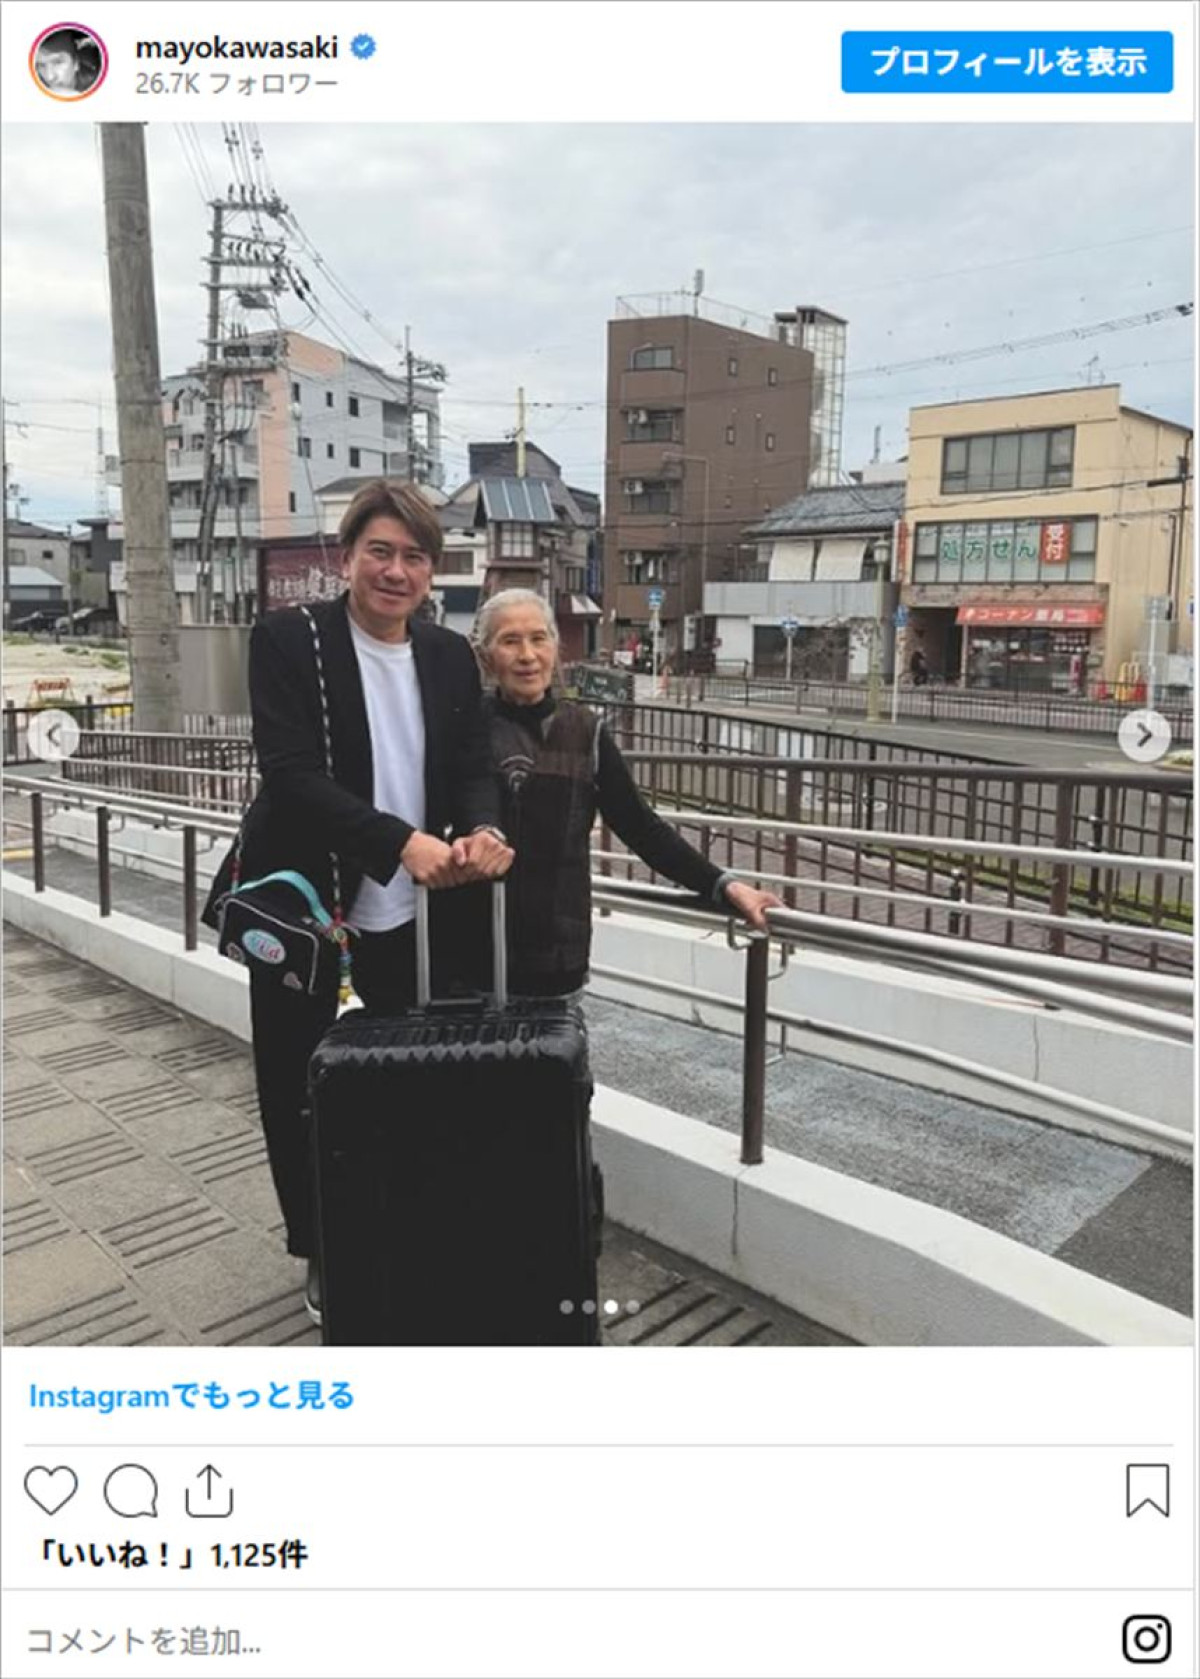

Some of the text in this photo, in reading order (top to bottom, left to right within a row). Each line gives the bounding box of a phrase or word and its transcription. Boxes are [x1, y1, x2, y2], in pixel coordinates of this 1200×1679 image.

[941, 537, 1037, 562] 処方せん
[1045, 523, 1065, 561] 受付
